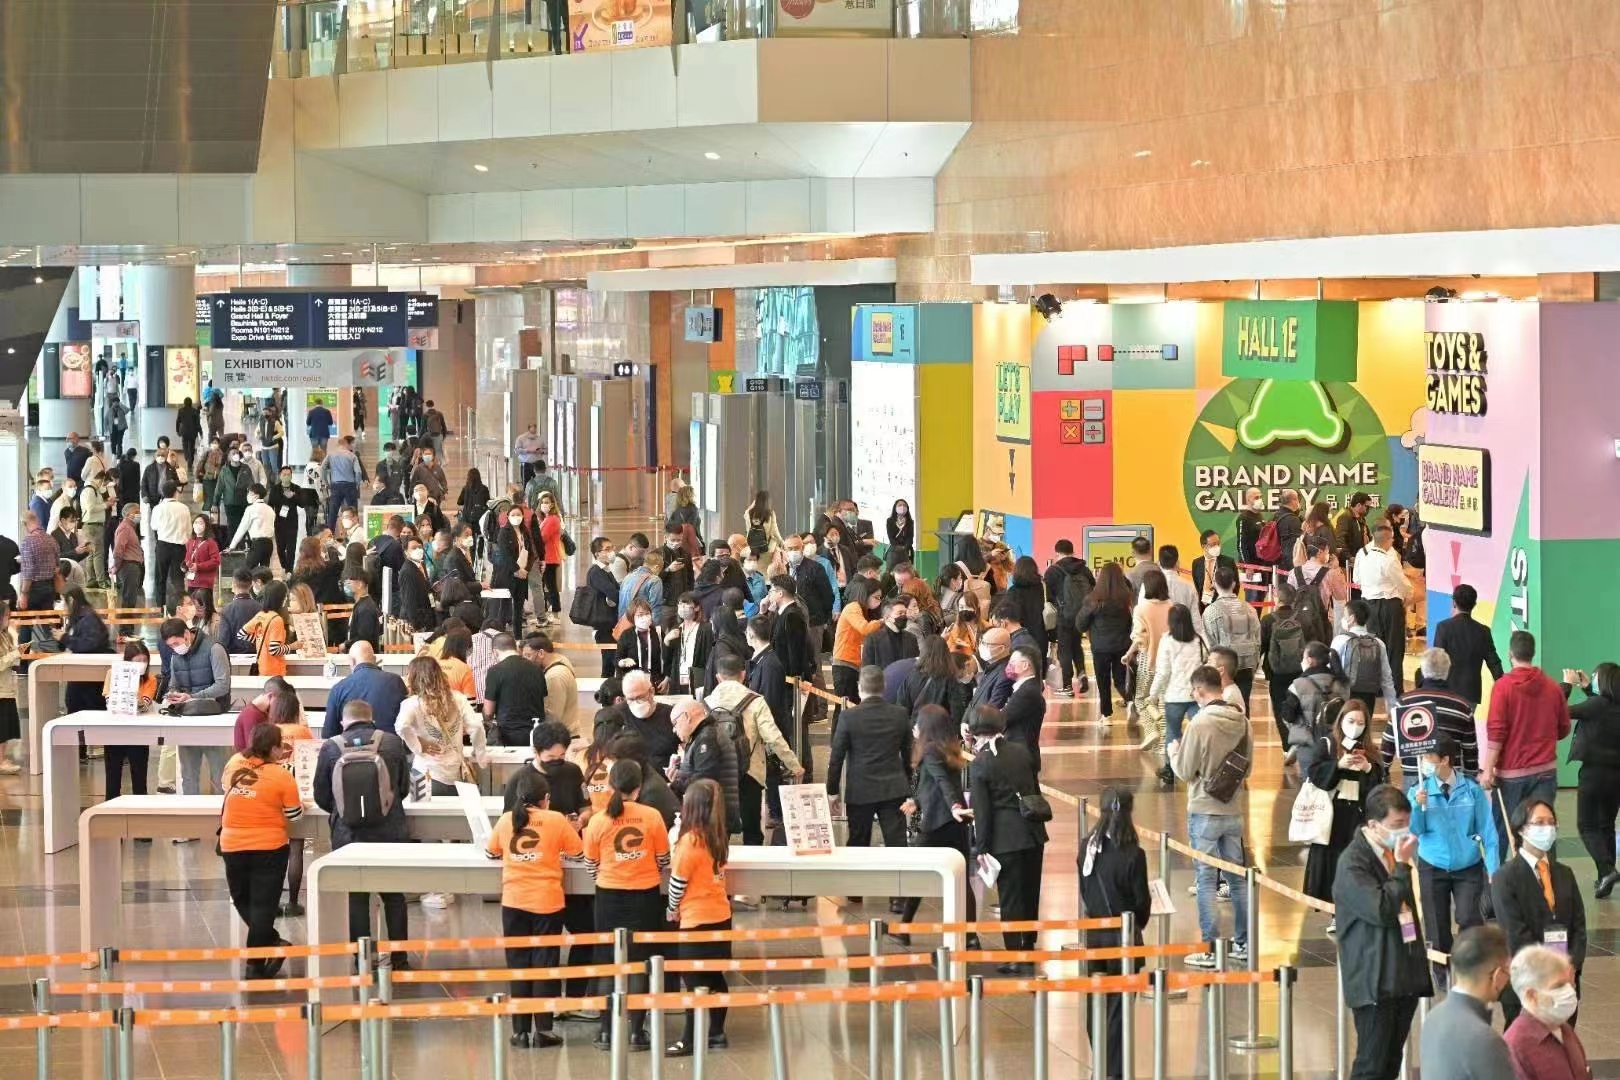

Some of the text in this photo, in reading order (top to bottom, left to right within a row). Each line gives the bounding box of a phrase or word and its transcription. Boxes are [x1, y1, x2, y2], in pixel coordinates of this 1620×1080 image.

[1238, 316, 1297, 358] HALL 1E
[1424, 331, 1482, 371] TOYS &
[224, 359, 294, 369] EXHIBITION
[1425, 374, 1482, 414] GAMES
[1195, 462, 1377, 487] BRAND NAME
[1421, 460, 1479, 489] BRAND NAME
[1422, 484, 1460, 509] GALLERY
